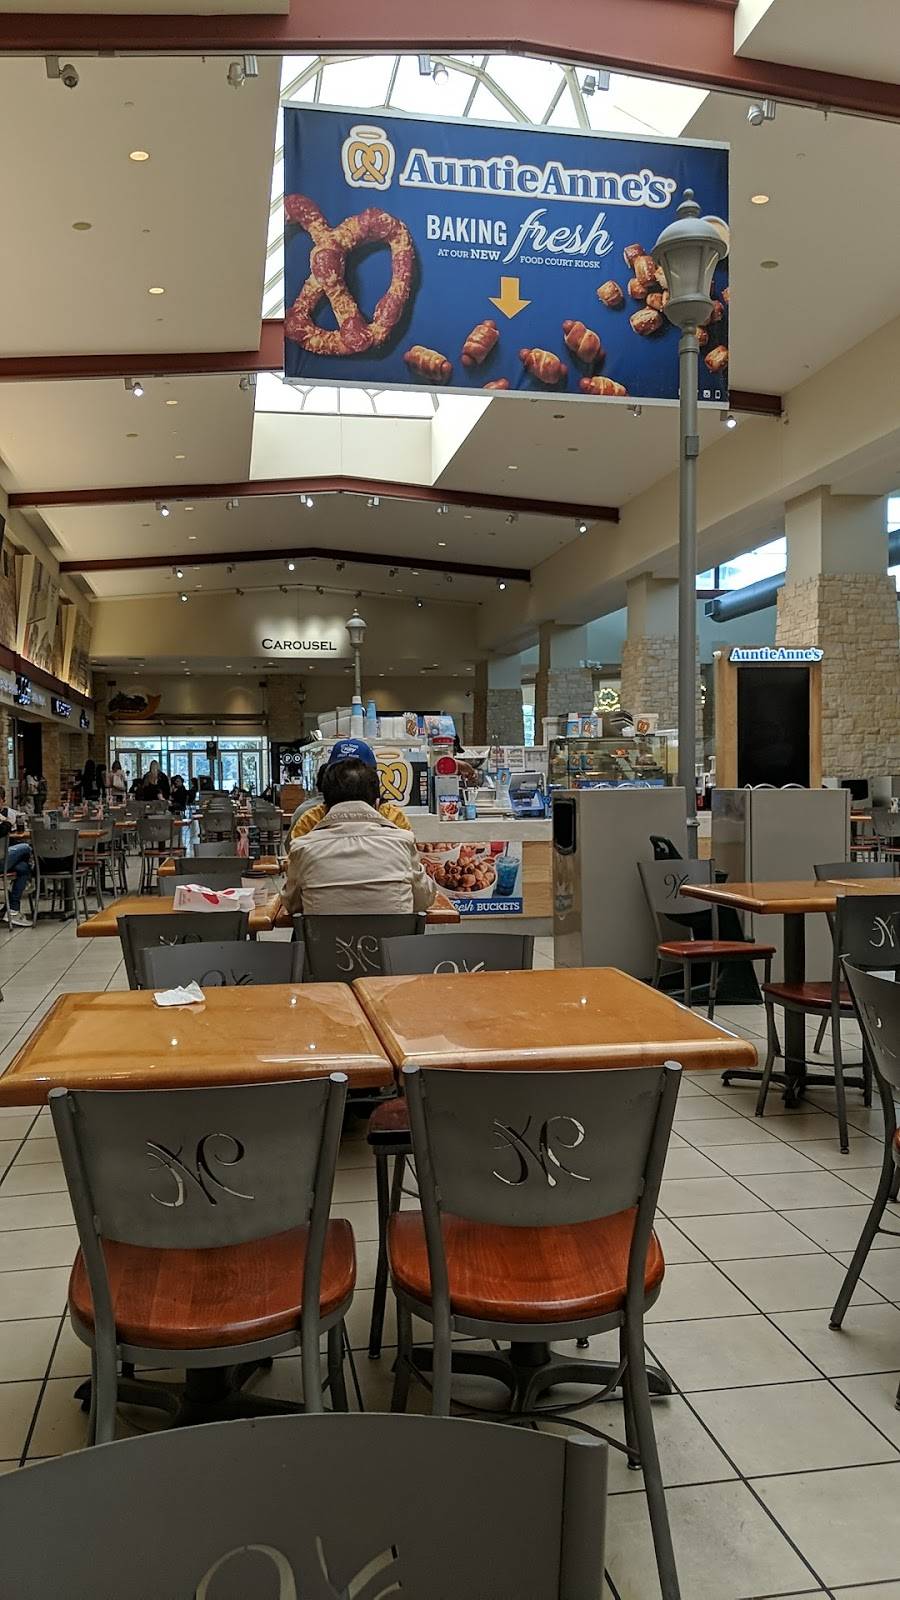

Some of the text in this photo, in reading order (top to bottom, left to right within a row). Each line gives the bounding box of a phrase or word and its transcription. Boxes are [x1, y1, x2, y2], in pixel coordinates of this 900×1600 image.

[427, 208, 614, 265] BAKING fresh
[437, 248, 601, 269] AT OUR NEW FOOD COURT KIOSK
[476, 902, 520, 911] BUCKETS
